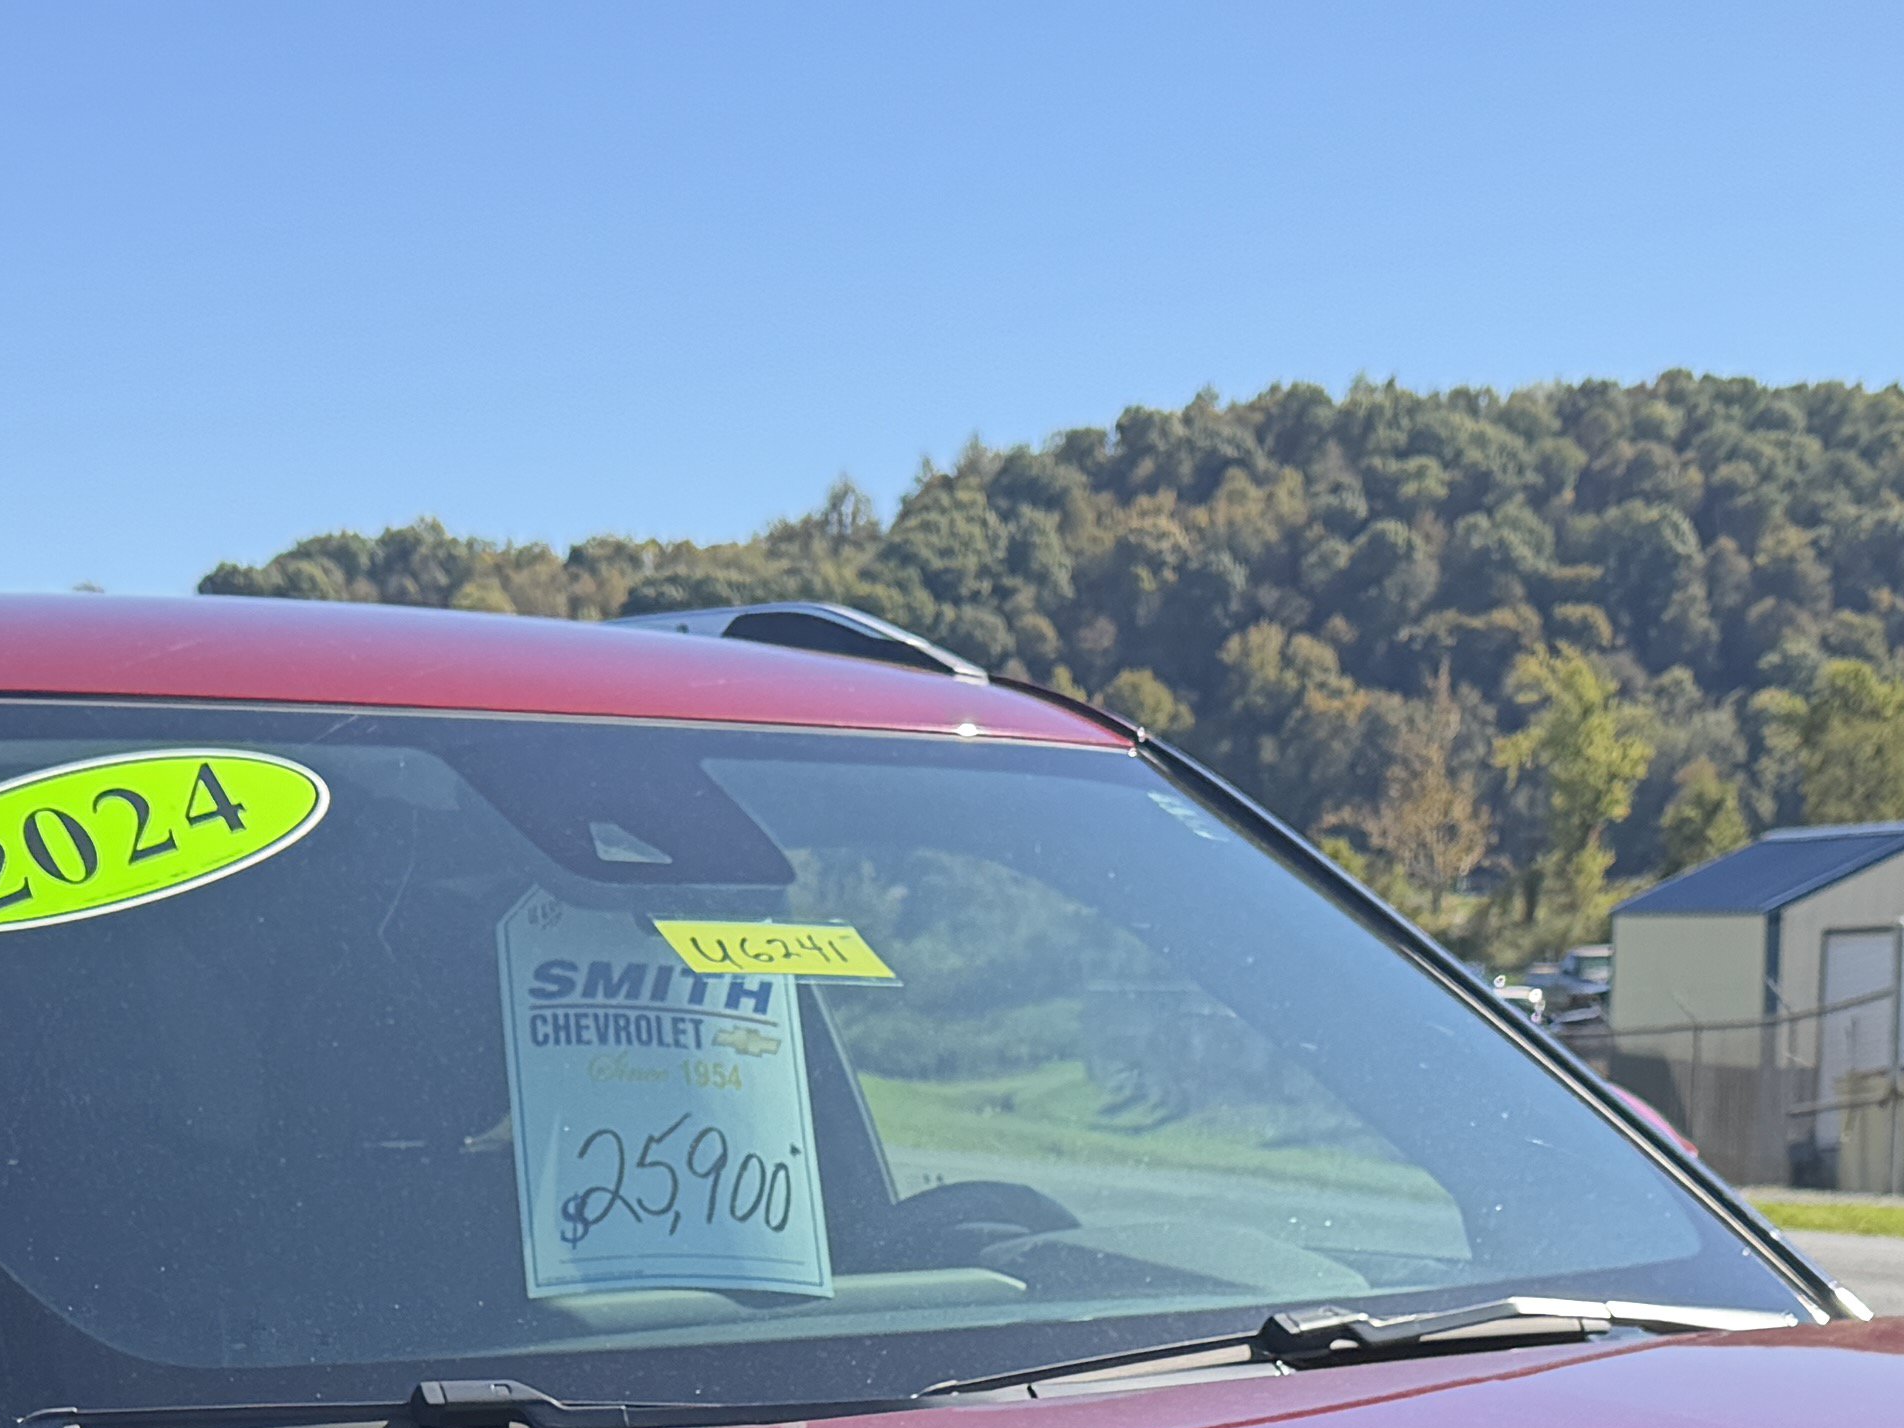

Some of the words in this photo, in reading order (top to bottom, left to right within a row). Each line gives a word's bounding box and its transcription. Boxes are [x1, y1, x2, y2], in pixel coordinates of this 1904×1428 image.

[527, 957, 774, 1016] SMITH
[529, 1012, 705, 1050] CHEVROLET
[680, 1060, 744, 1091] 1954
